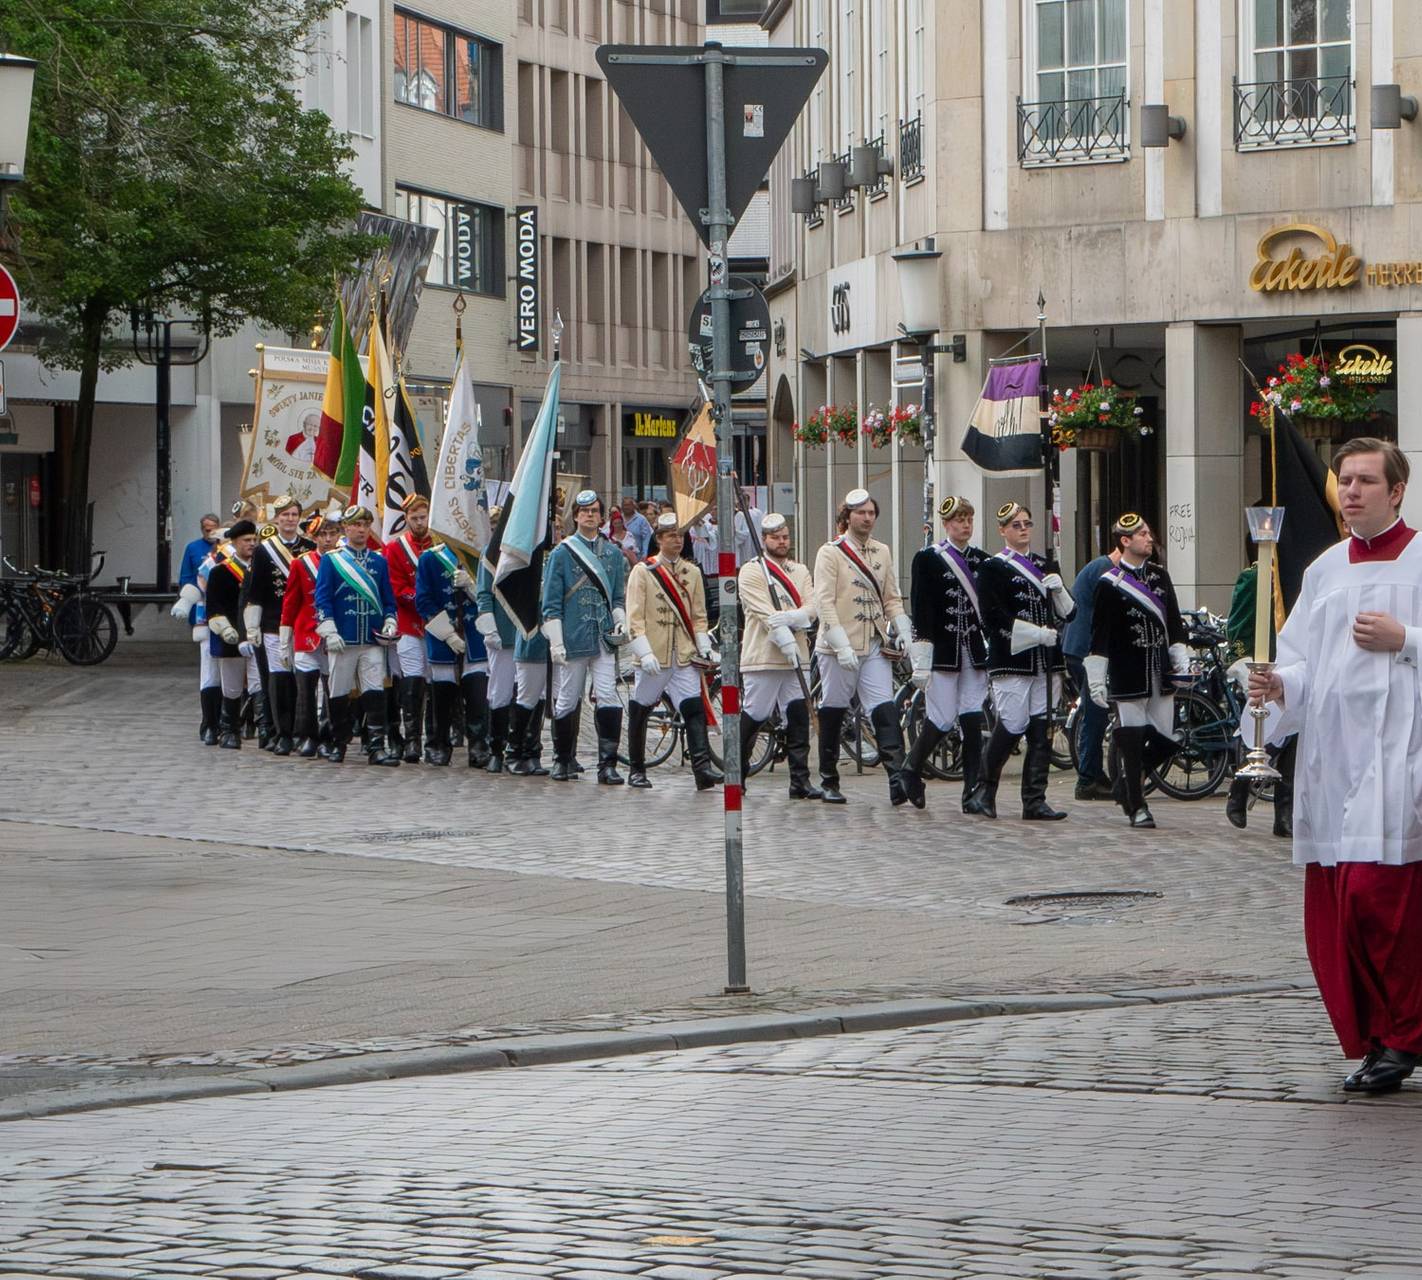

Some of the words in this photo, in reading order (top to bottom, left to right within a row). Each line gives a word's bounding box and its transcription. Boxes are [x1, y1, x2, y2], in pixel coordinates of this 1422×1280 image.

[519, 210, 535, 280] MODA
[1249, 223, 1361, 292] Eckerle
[520, 284, 535, 348] VERO
[1335, 344, 1393, 375] Eckerle
[1169, 503, 1192, 518] FREE
